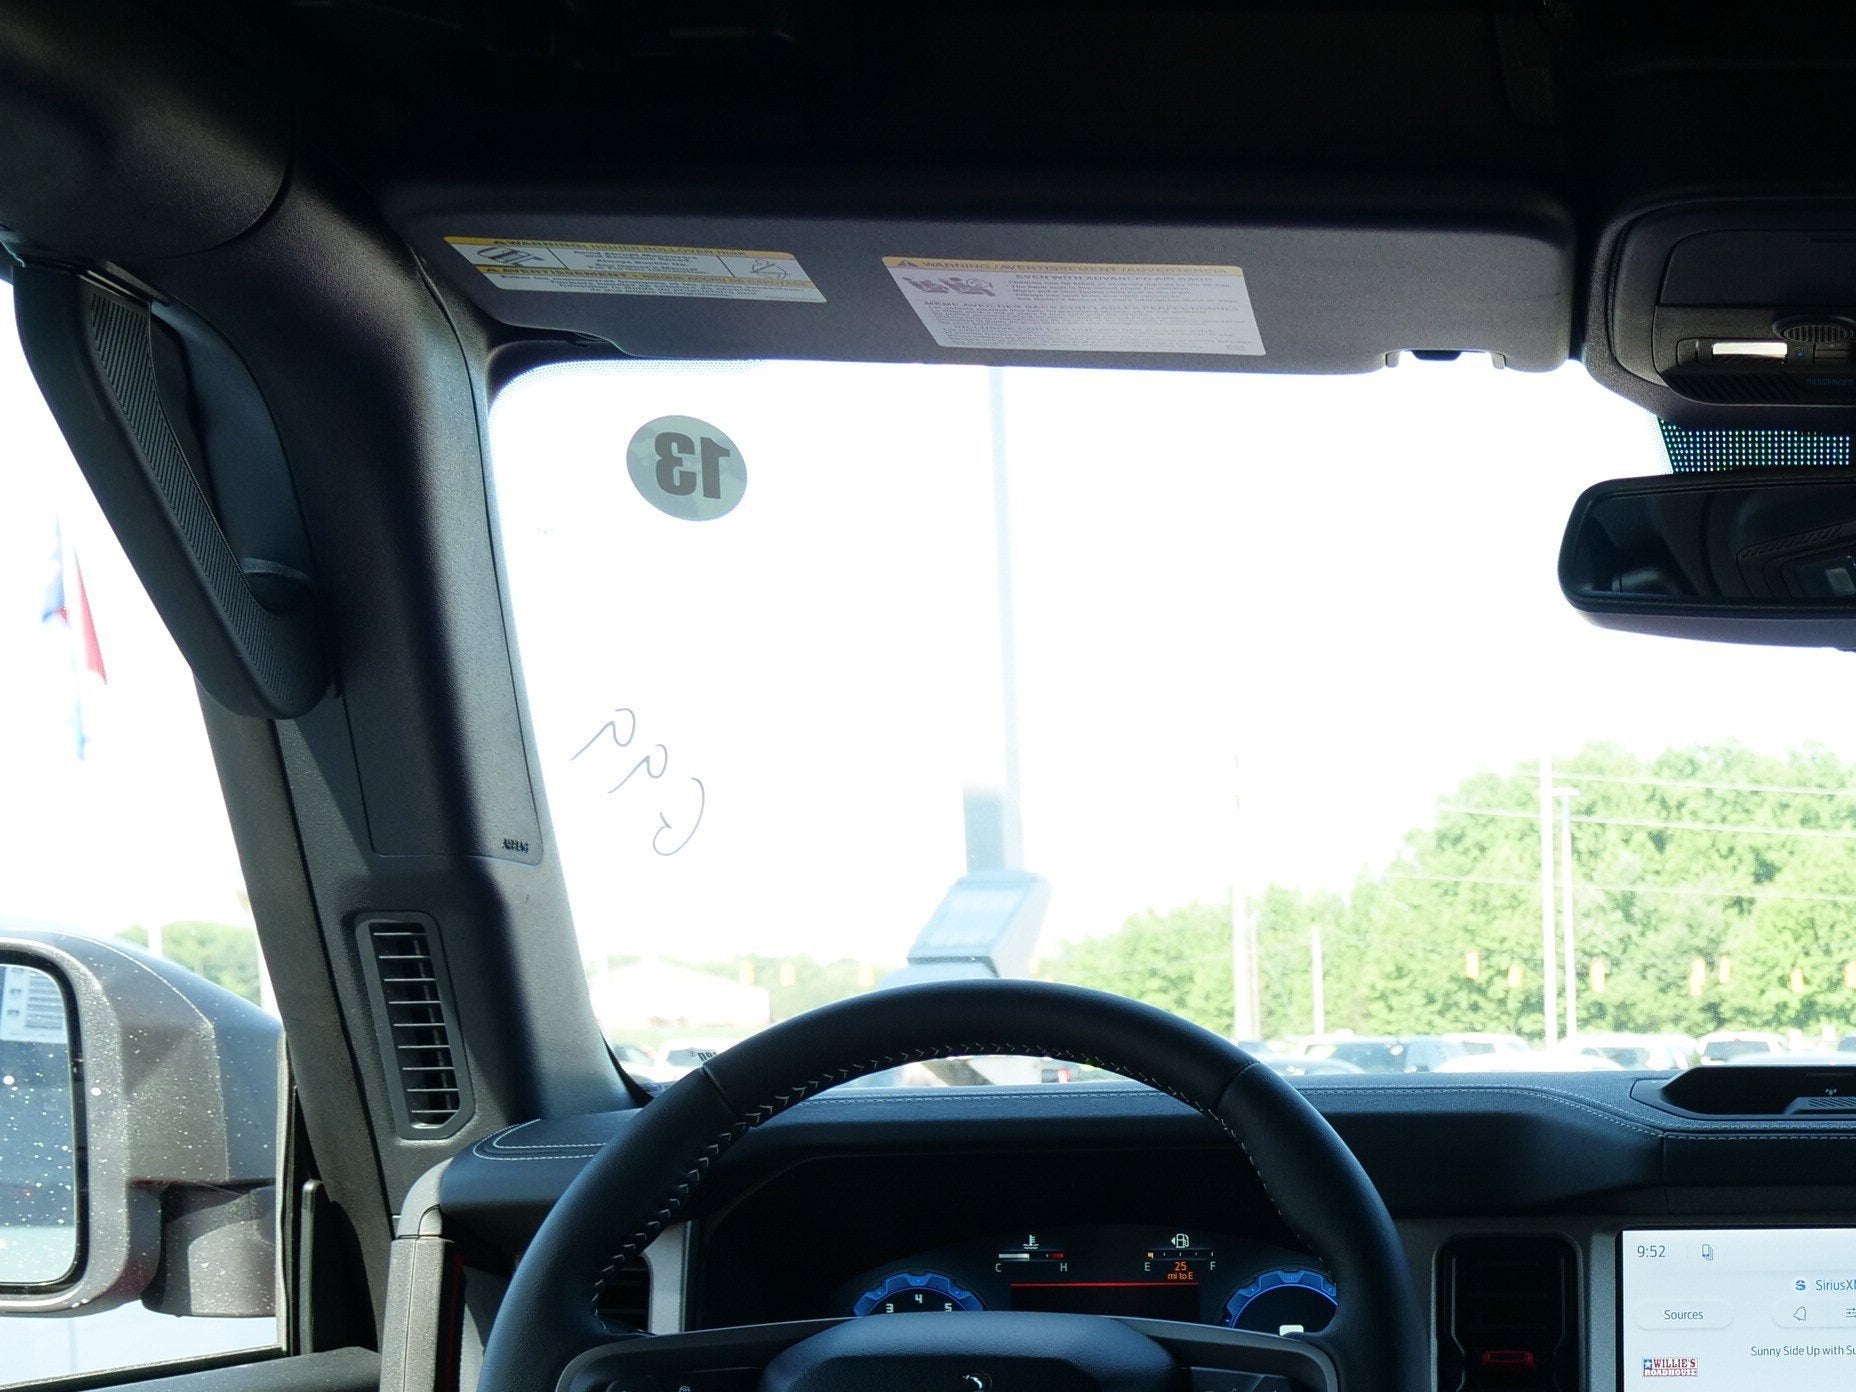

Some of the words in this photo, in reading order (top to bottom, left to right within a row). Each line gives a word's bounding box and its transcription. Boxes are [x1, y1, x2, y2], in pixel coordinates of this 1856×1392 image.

[1636, 1245, 1666, 1258] 9:52
[995, 1264, 1001, 1273] C
[1060, 1263, 1068, 1272] H
[1145, 1262, 1150, 1271] E
[1174, 1262, 1187, 1271] 25
[1210, 1262, 1216, 1271] F
[915, 1294, 923, 1303] 4
[886, 1304, 894, 1313] 3
[945, 1303, 952, 1312] 5
[1664, 1309, 1704, 1321] Sources
[1751, 1346, 1781, 1358] Sunny
[1784, 1345, 1805, 1356] Side
[1806, 1346, 1821, 1358] Up
[1822, 1345, 1844, 1356] with
[1653, 1358, 1697, 1368] WILLIE'S
[1644, 1368, 1697, 1376] ROADHOUSE
